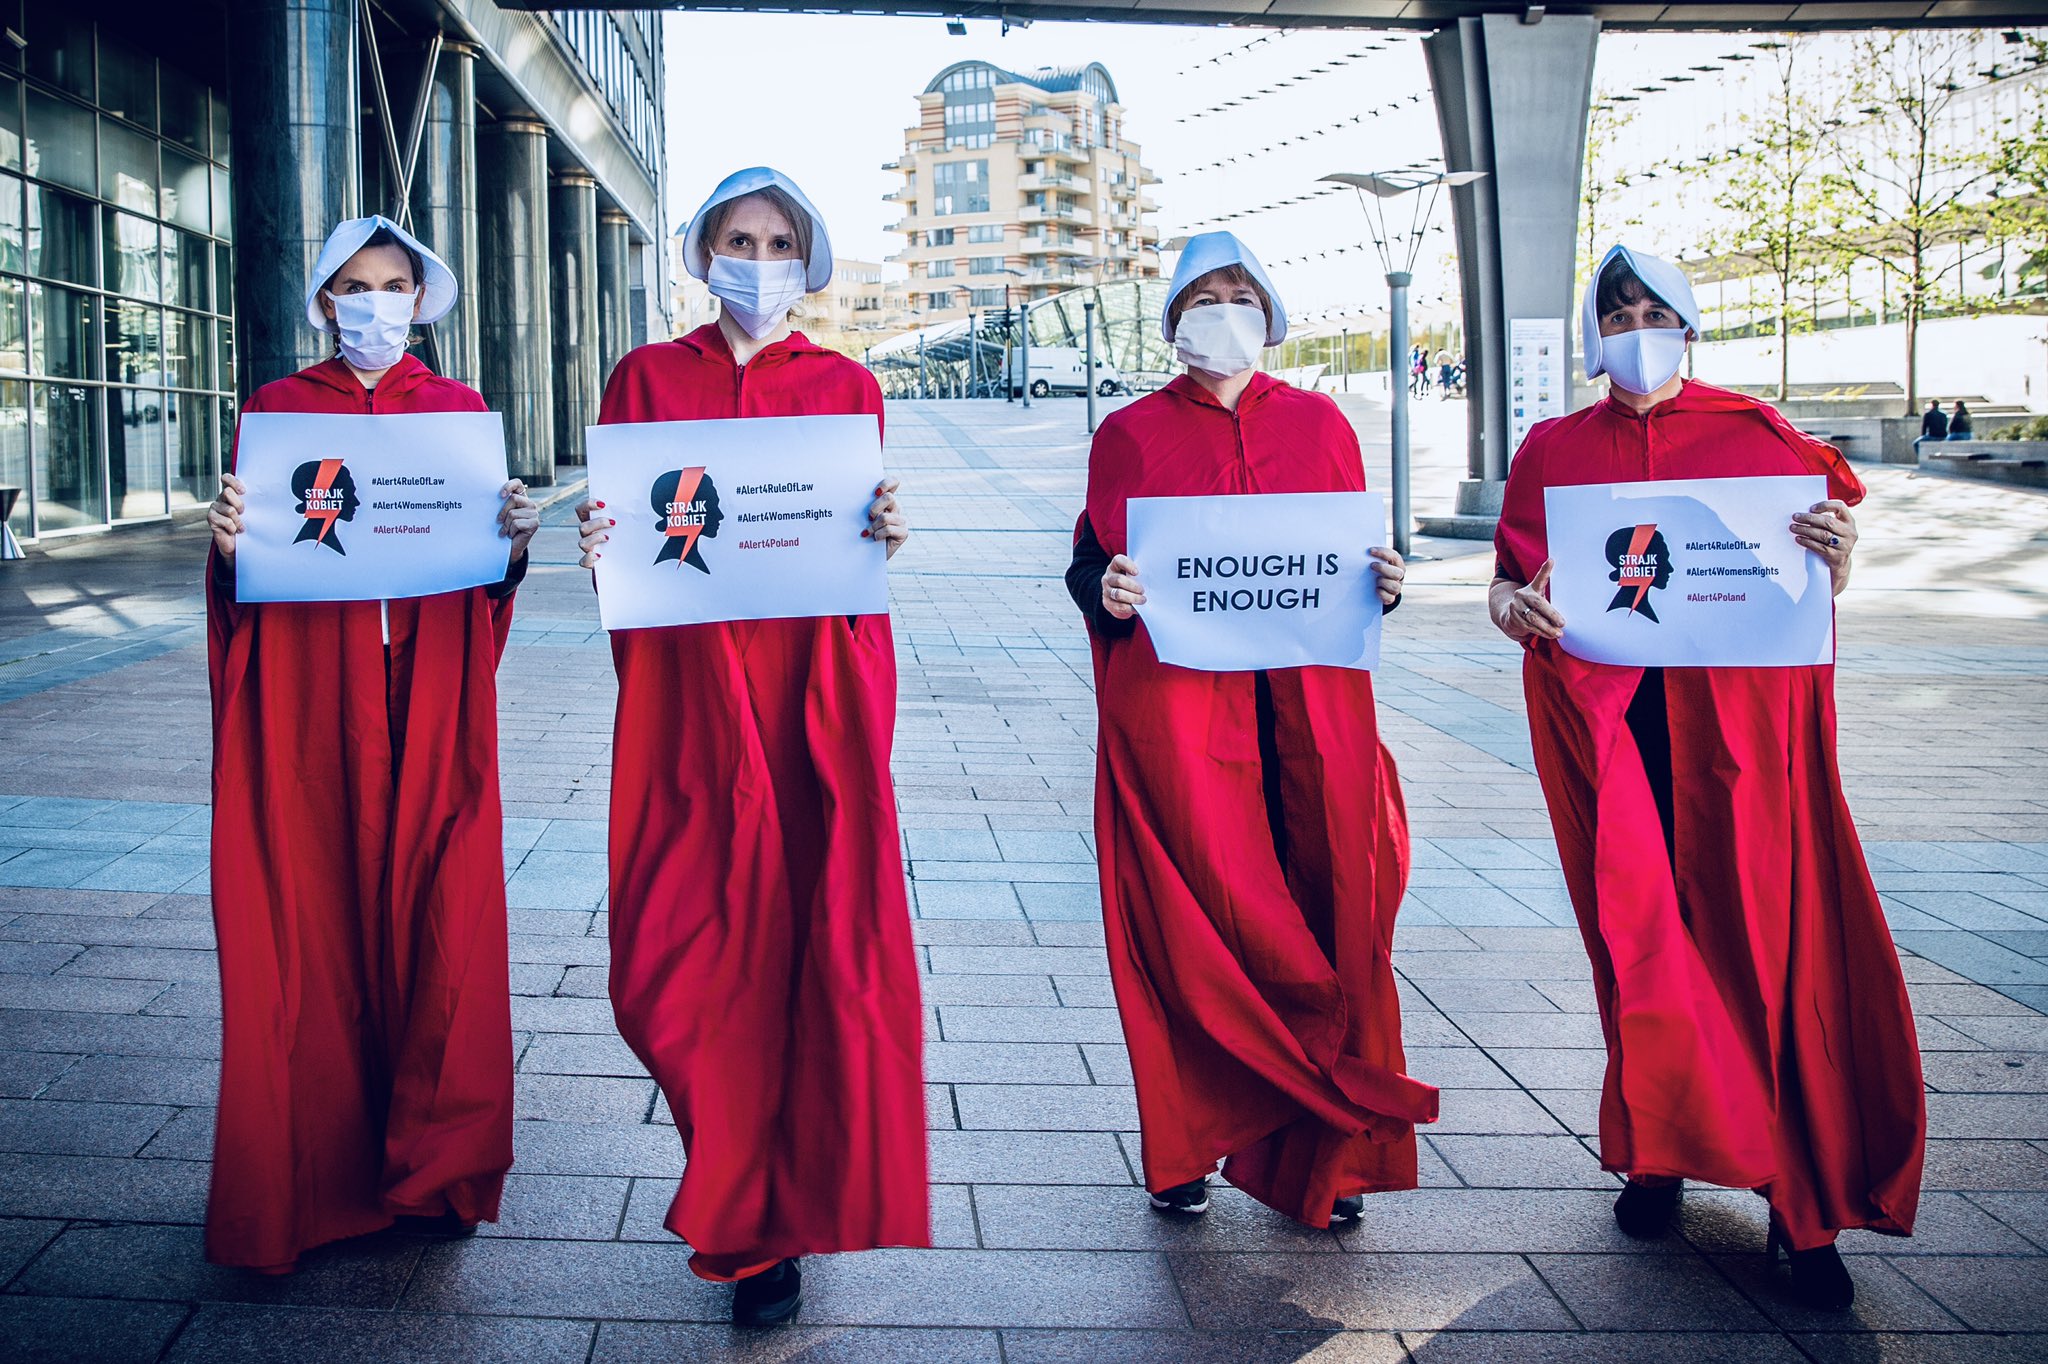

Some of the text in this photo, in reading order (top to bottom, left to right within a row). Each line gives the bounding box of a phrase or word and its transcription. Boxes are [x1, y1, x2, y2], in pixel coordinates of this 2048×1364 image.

[371, 476, 446, 487] #Alert4RuleOfLaw
[305, 488, 344, 500] STRAJK
[735, 482, 814, 496] #Alert4RuleOfLaw
[306, 500, 344, 511] KOBIET
[372, 501, 463, 511] #Alert4WomensRights
[665, 500, 707, 515] STRAJK
[666, 513, 707, 527] KOBIET
[737, 509, 833, 523] #Alert4WomensRights
[373, 525, 431, 535] #Alert4Poland
[738, 537, 800, 550] #Alert4Poland
[1685, 541, 1761, 551] #Alert4RuleOfLaw
[1177, 553, 1339, 579] ENOUGH IS
[1619, 554, 1658, 566] STRAJK
[1619, 566, 1658, 578] KOBIET
[1686, 566, 1779, 577] #Alert4WomensRights
[1193, 588, 1320, 613] ENOUGH
[1687, 593, 1746, 602] #Alert4Poland
